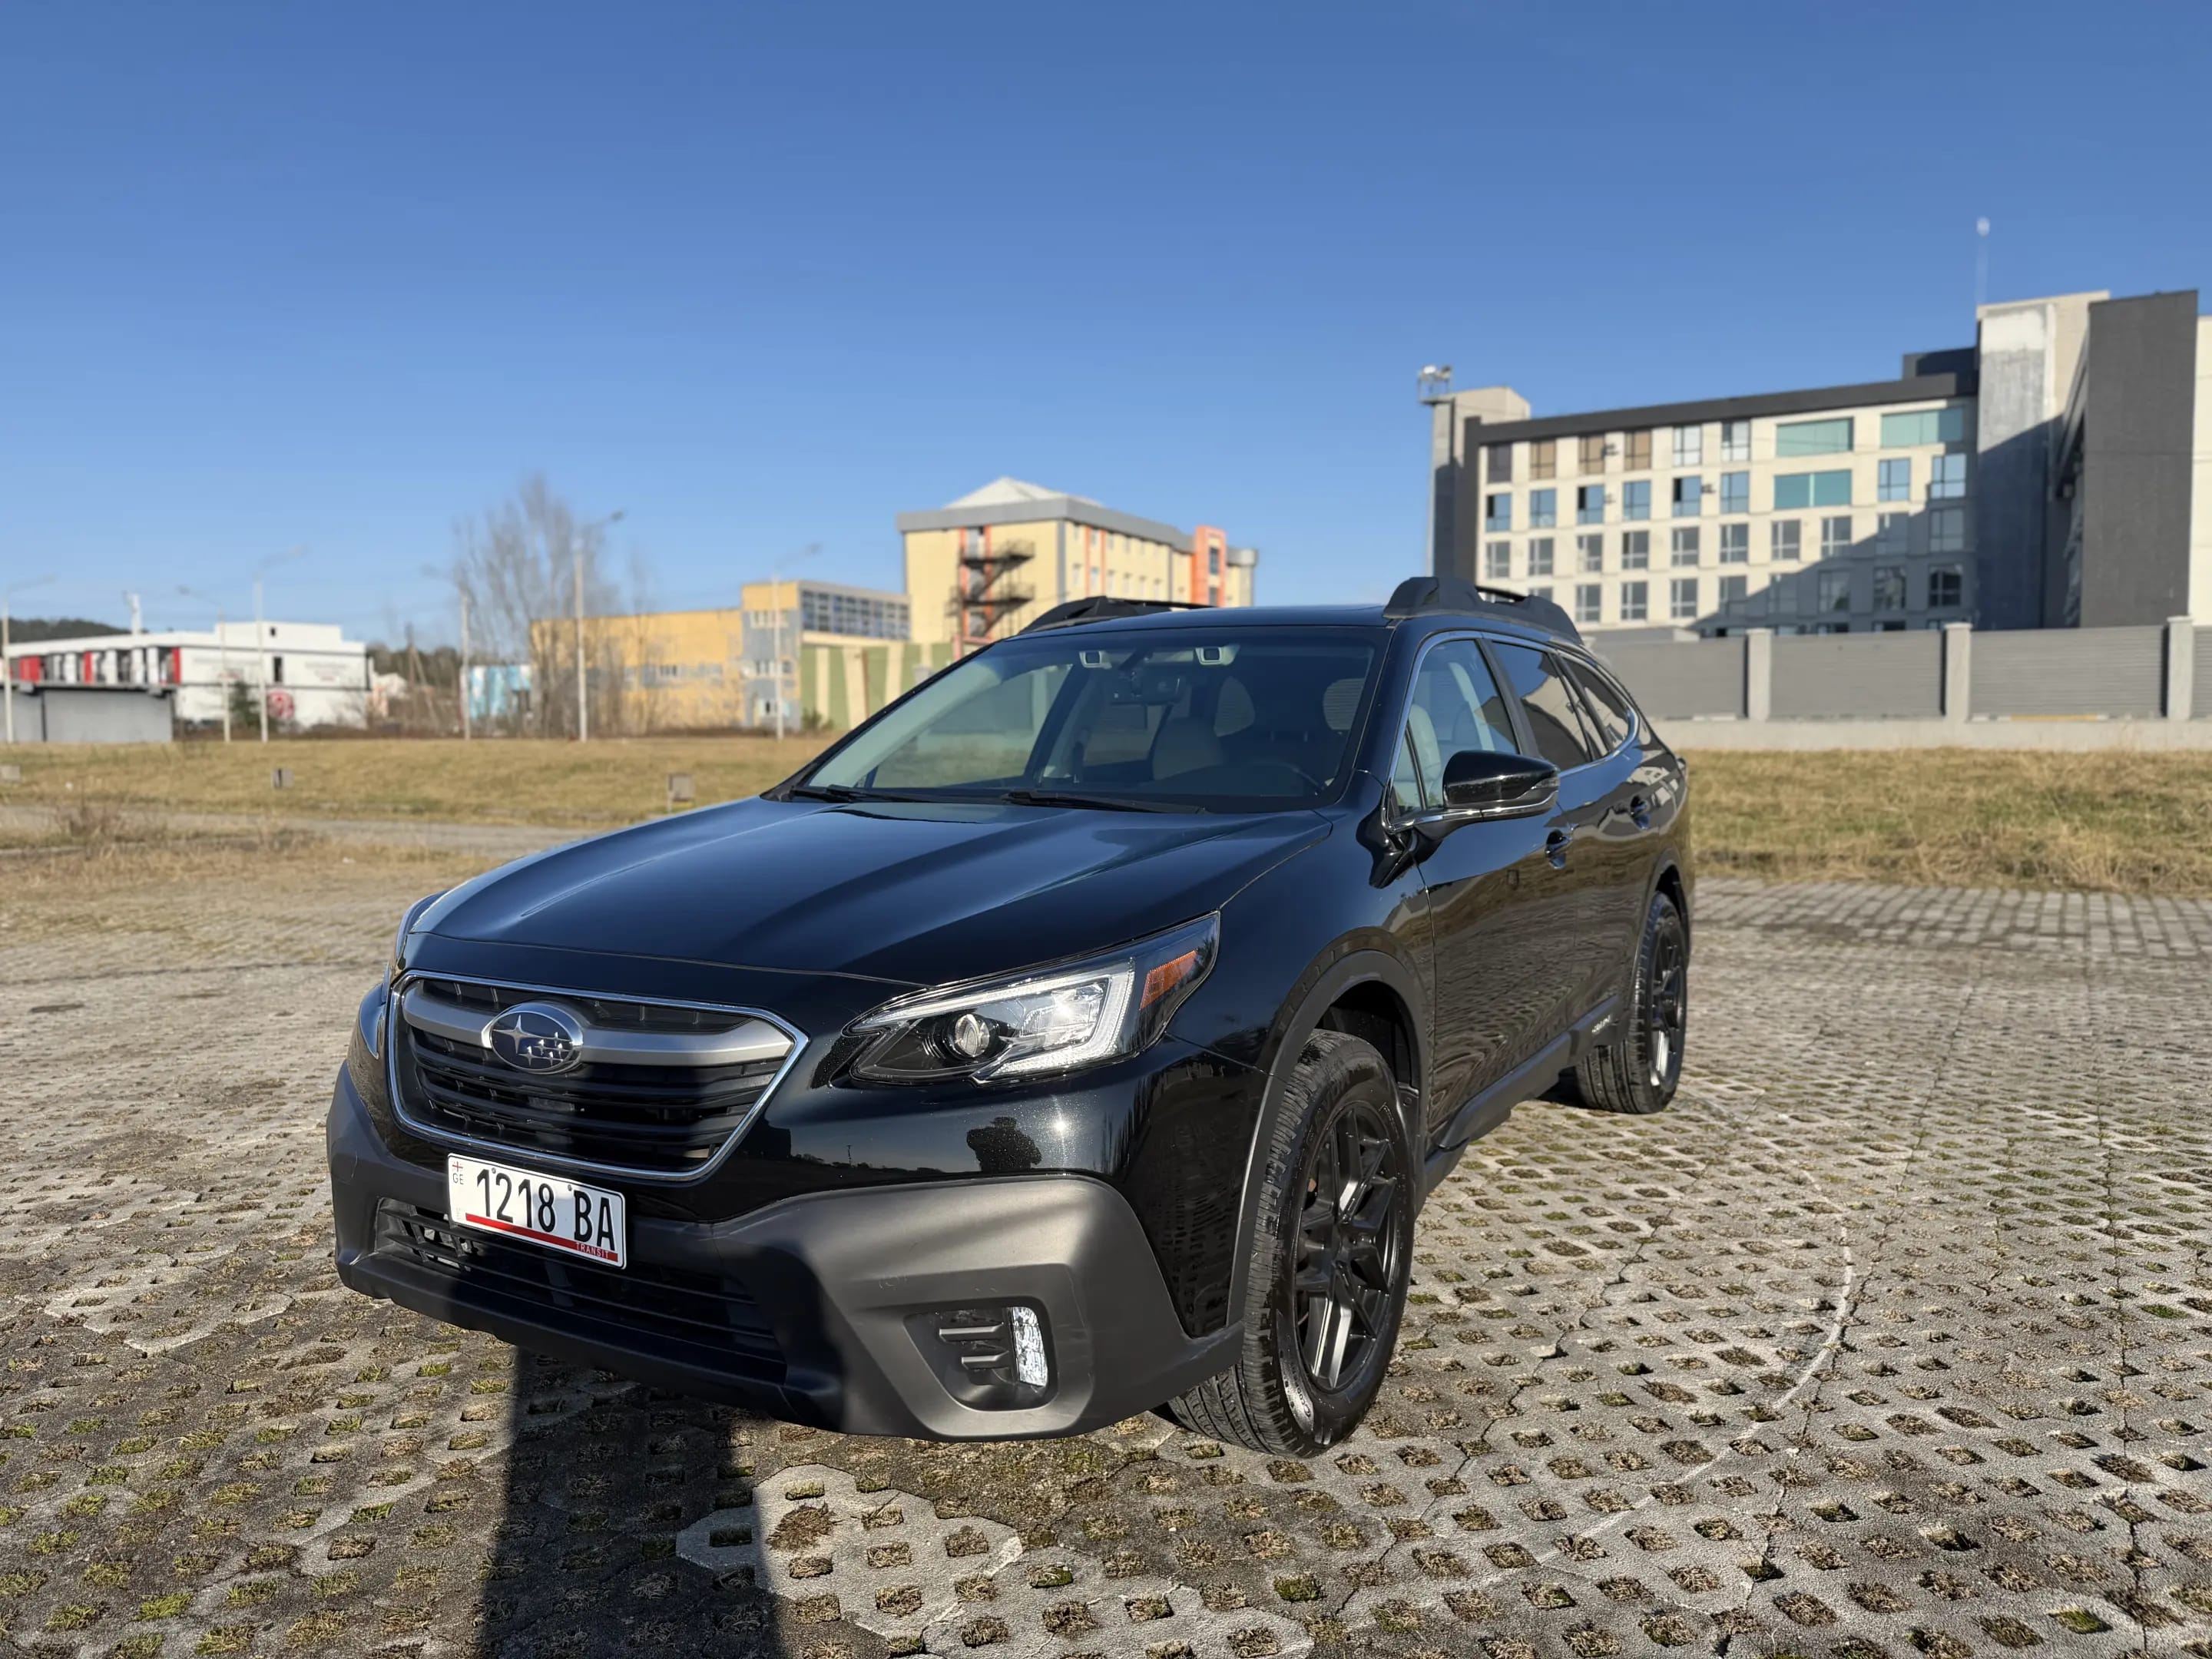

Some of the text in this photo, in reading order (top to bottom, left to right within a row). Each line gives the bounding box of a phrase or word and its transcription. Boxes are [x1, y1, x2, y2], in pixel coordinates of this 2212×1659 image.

[452, 1174, 464, 1185] GE
[476, 1168, 616, 1251] 1218 BA
[575, 1242, 609, 1259] TRANSIT
